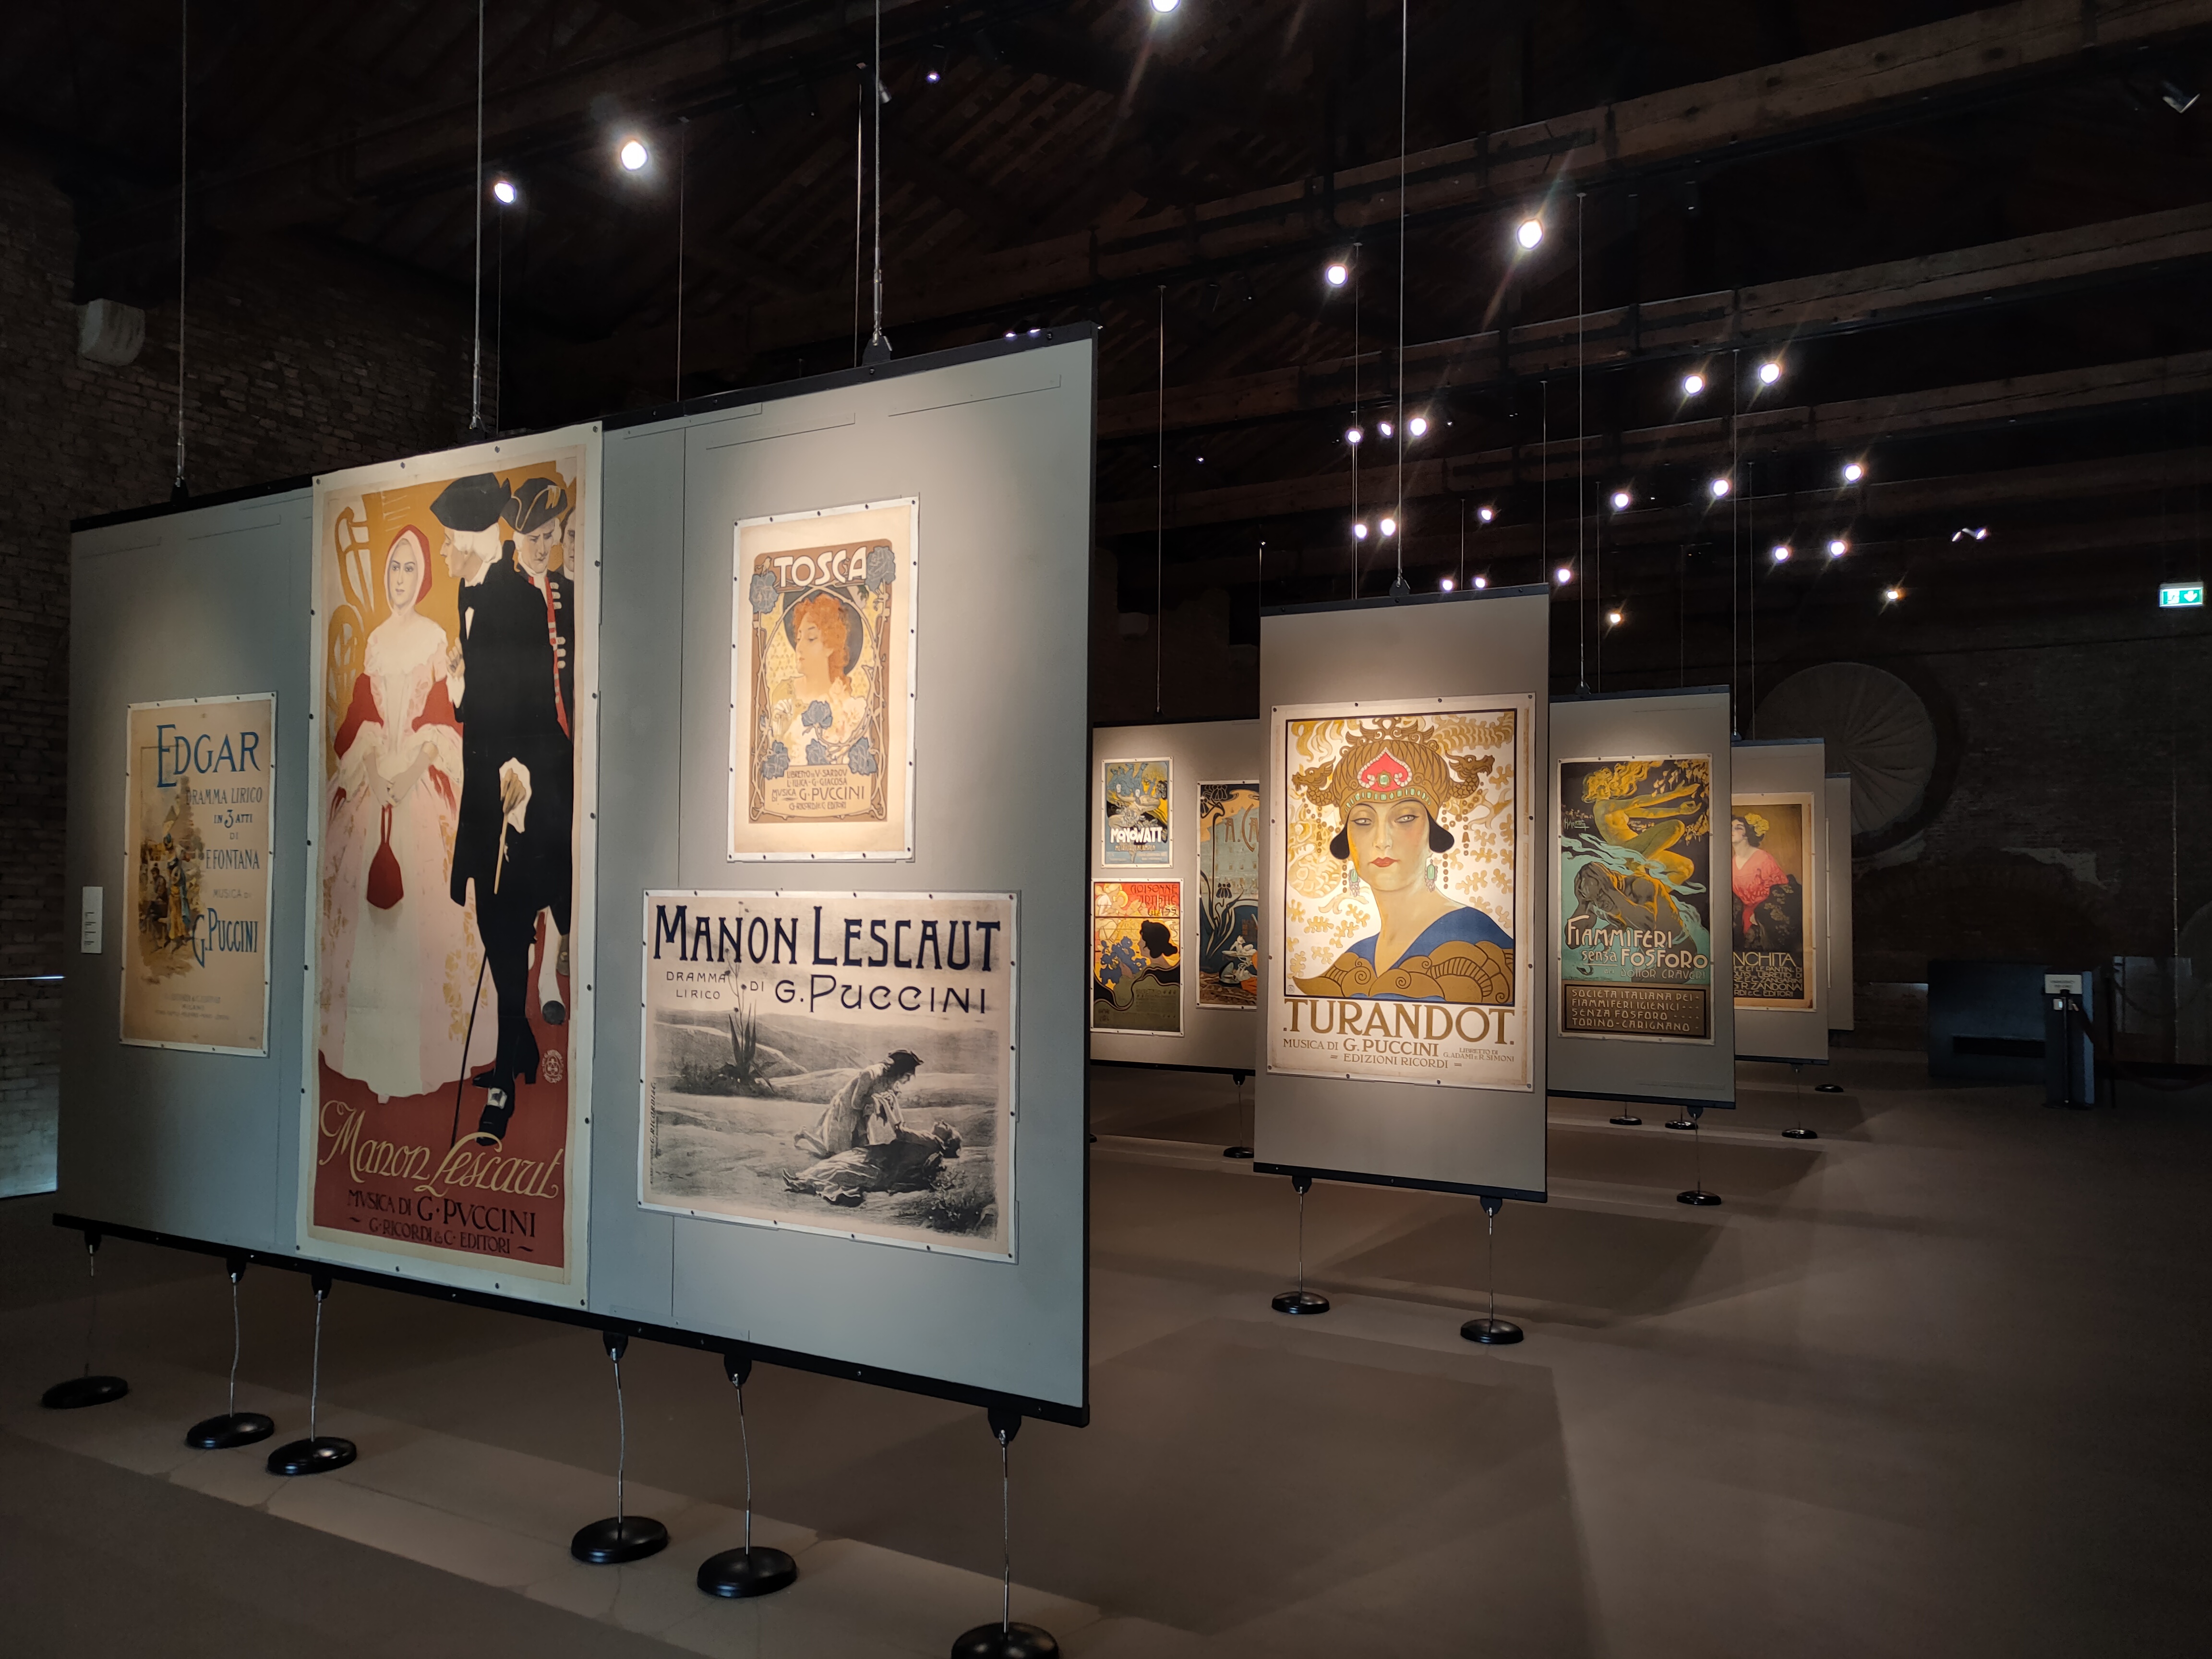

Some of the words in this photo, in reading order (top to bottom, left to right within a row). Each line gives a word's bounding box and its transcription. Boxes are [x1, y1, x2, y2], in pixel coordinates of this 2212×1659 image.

[773, 546, 867, 588] TOSCA
[156, 724, 261, 788] EDGAR
[231, 787, 263, 804] LIRICO
[214, 815, 223, 824] IN
[224, 809, 234, 829] 3
[235, 814, 253, 823] ATTI
[1110, 827, 1163, 843] MOYOWATT
[653, 904, 799, 965] MANON
[812, 905, 1001, 972] LESCAUT
[1567, 915, 1672, 949] FIAMMIFERI
[666, 971, 726, 983] DRAMMA
[676, 989, 720, 999] LIRICO
[750, 981, 764, 992] DI
[1621, 991, 1671, 1001] ITALIANA
[1676, 993, 1693, 1001] DEI
[1572, 998, 1633, 1009] FIAMMIFERI
[1637, 1001, 1679, 1011] IGIENICI
[1572, 1008, 1611, 1018] SENZA
[1615, 1010, 1668, 1020] FOSFORO
[1283, 1038, 1325, 1050] MUSICA
[1327, 1041, 1338, 1050] DI
[1344, 1053, 1398, 1065] EDIZIONI
[1401, 1057, 1449, 1069] RICORDI
[319, 1100, 431, 1184] Manon
[414, 1131, 564, 1199] Lescaut
[399, 1197, 411, 1215] DI
[460, 1232, 510, 1254] EDITORI
